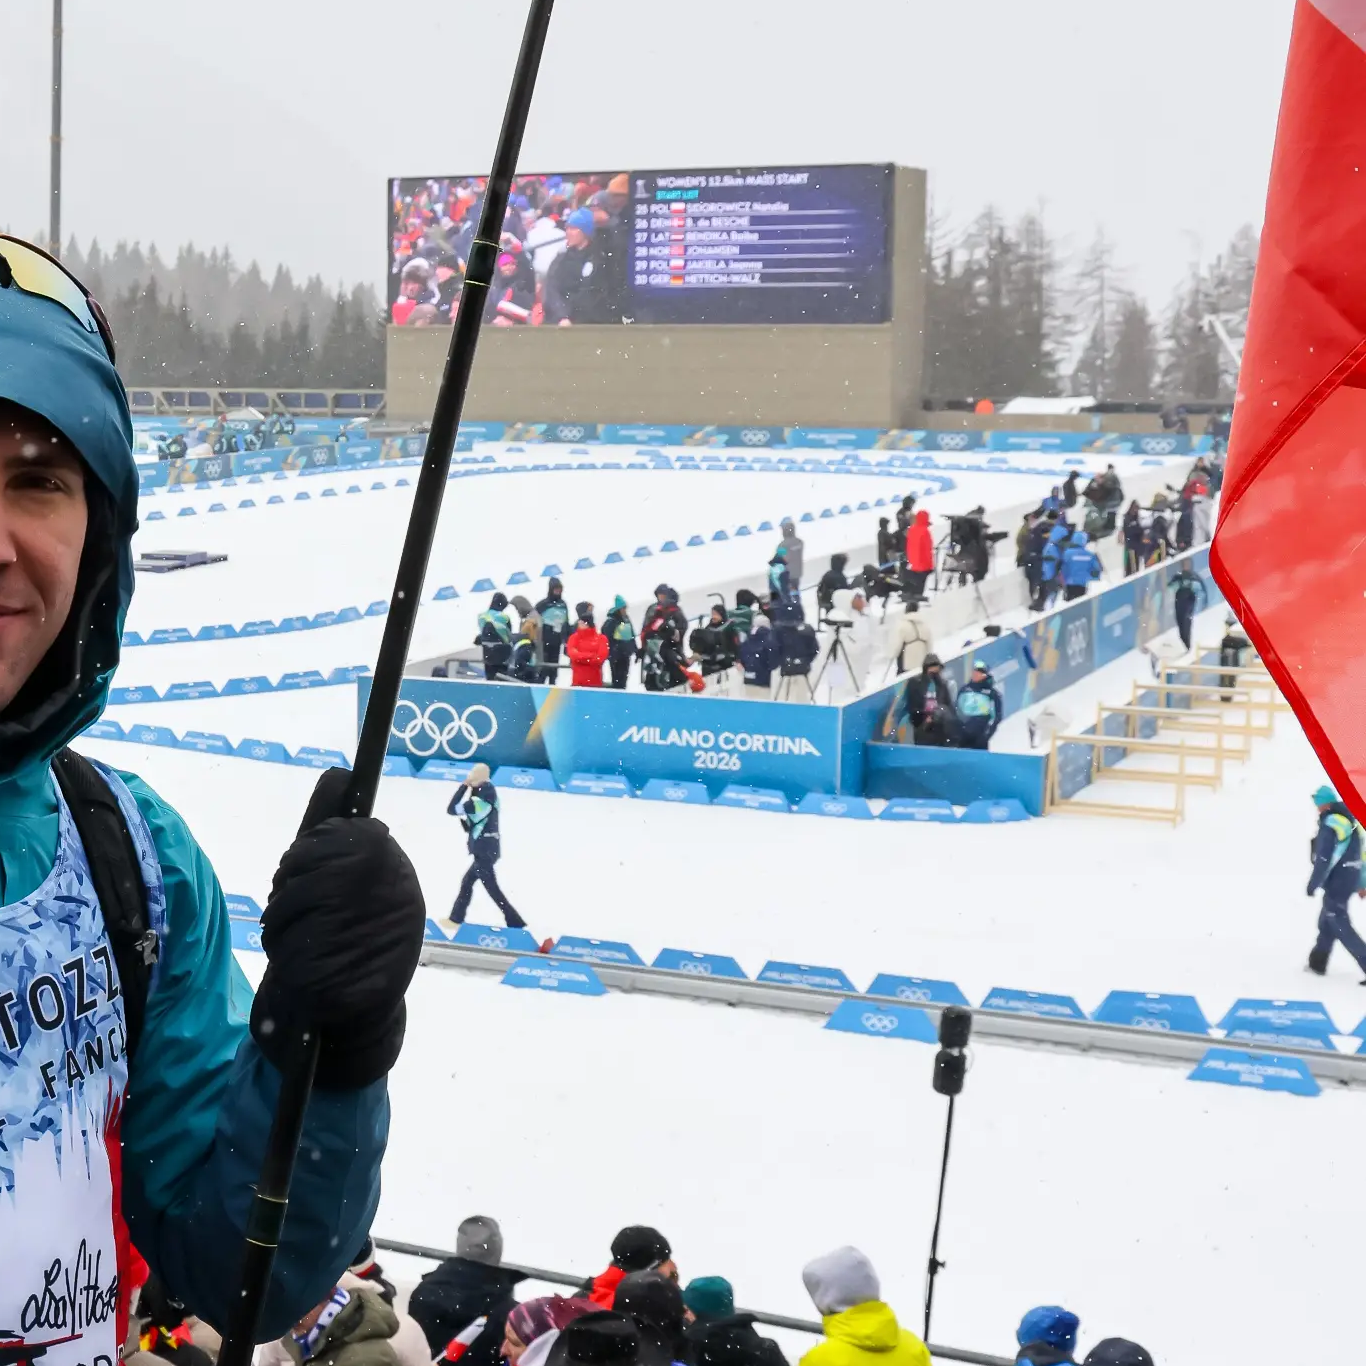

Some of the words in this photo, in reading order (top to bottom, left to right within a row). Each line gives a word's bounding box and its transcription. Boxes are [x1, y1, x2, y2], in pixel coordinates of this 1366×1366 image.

[656, 176, 707, 188] WOMEN'S
[776, 173, 809, 185] START
[618, 725, 715, 748] MILANO
[718, 731, 822, 757] CORTINA
[694, 750, 741, 771] 2026
